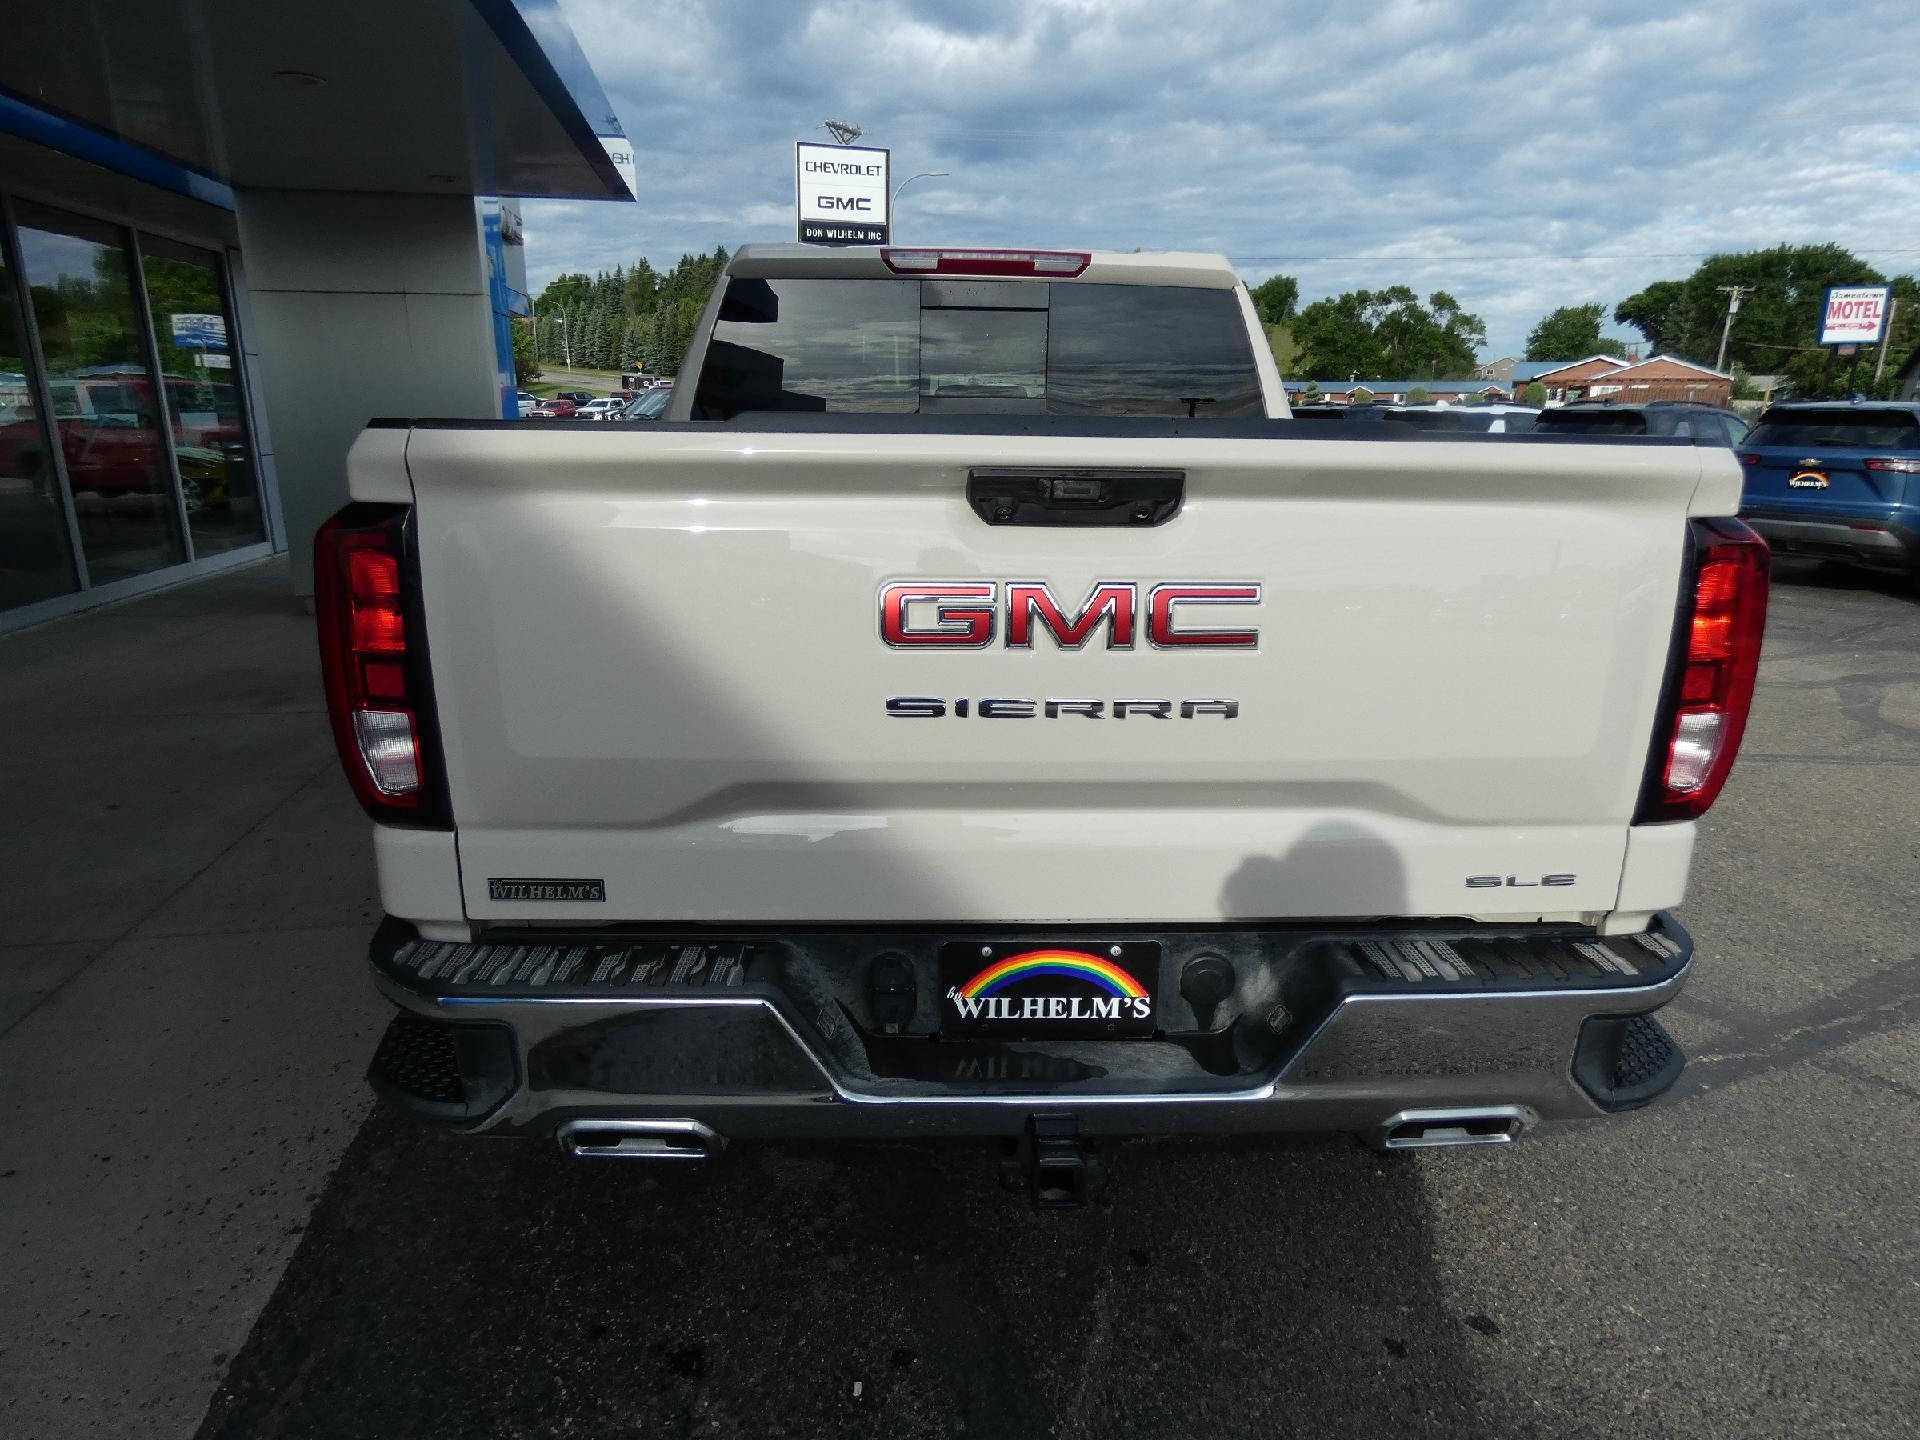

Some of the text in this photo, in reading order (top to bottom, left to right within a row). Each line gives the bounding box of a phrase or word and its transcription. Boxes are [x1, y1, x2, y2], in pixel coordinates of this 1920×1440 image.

[806, 161, 882, 176] CHEVROLET
[818, 196, 871, 211] GMC
[806, 228, 823, 237] DON
[868, 231, 882, 240] INC
[1827, 301, 1882, 319] MOTEL
[879, 581, 1262, 651] GMC
[886, 696, 1239, 719] SIERRA
[1465, 874, 1576, 888] SLE
[491, 884, 600, 899] WILHELM'S
[947, 986, 1151, 1019] by WILHELM'S
